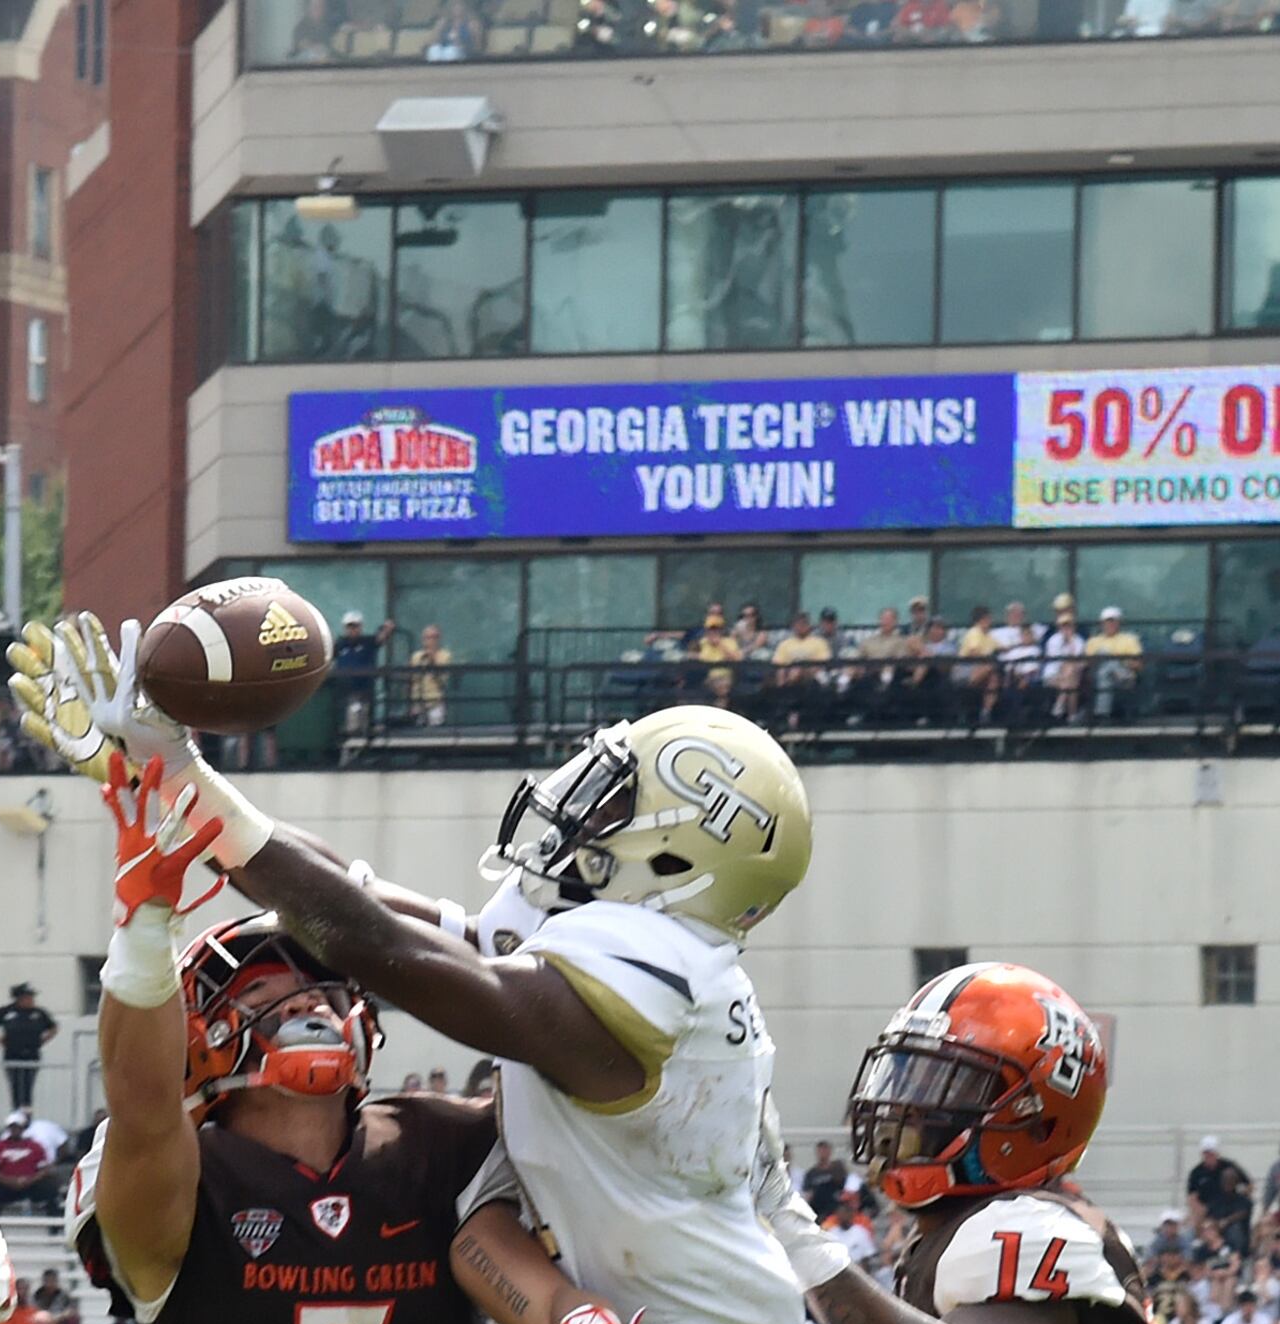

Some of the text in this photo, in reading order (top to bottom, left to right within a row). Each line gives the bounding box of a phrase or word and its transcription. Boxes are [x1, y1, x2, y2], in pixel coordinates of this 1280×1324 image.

[501, 408, 688, 456] GEORGIA
[846, 398, 976, 447] WINS!
[1045, 386, 1196, 461] 50%
[315, 429, 384, 470] PAPA
[636, 462, 835, 511] YOU WIN!
[1040, 479, 1099, 506] USE
[1111, 476, 1226, 503] PROMO
[259, 626, 308, 645] adidas
[242, 1259, 437, 1294] BOWLING GREEN
[991, 1230, 1070, 1301] 14
